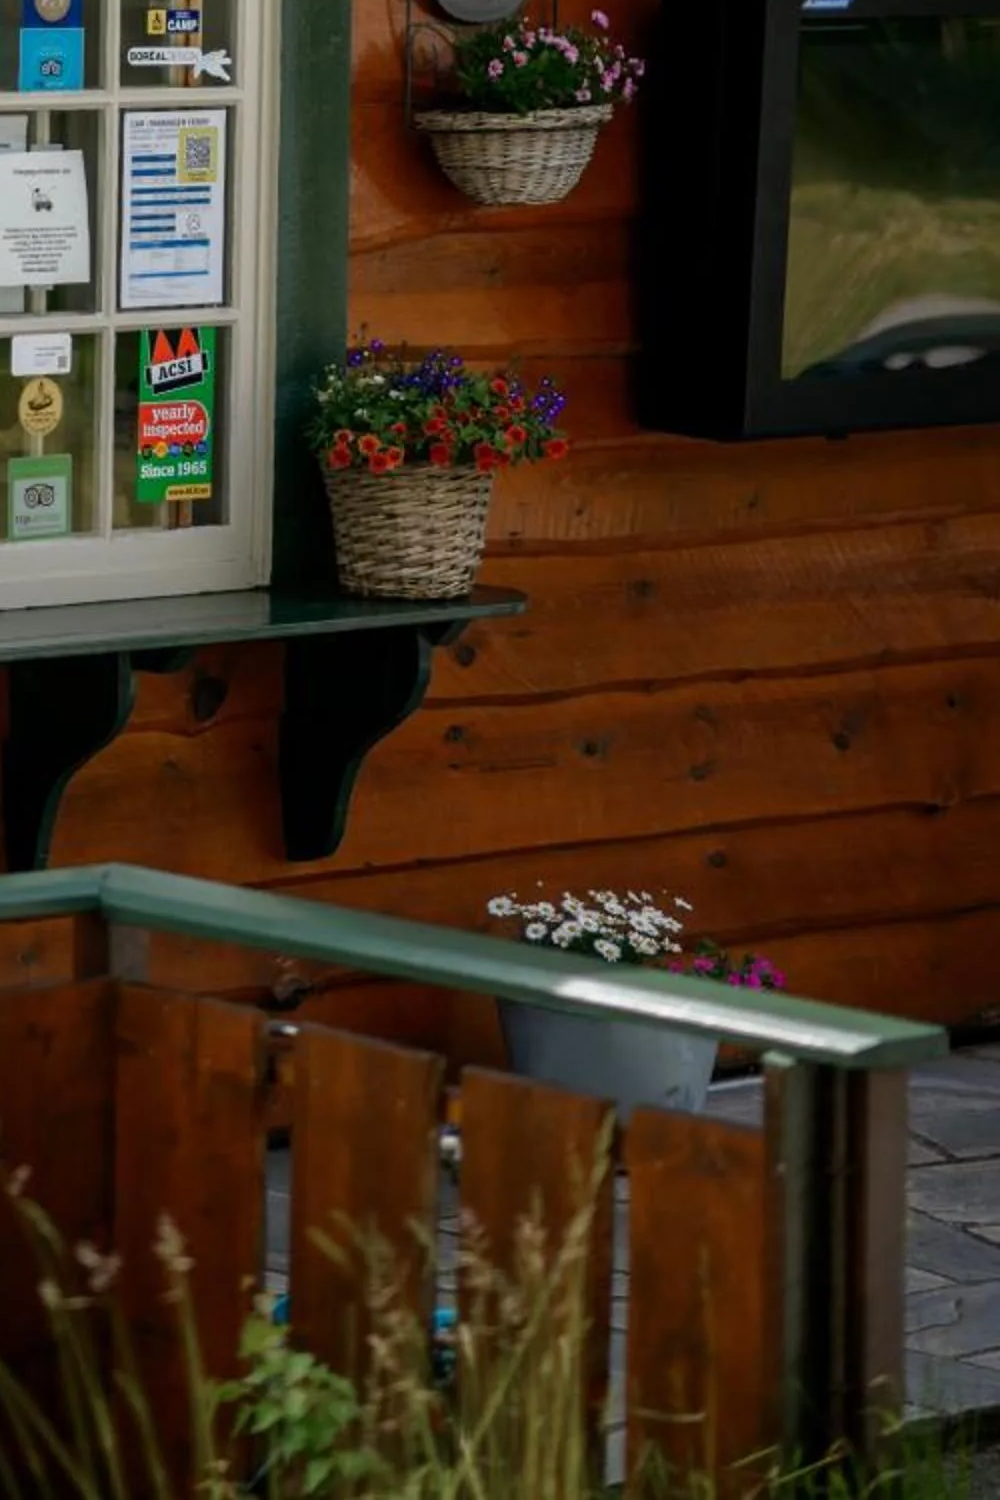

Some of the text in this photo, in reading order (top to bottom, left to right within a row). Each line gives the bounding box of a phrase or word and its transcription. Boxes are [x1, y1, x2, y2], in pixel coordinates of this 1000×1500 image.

[168, 19, 198, 32] CAMP
[158, 359, 194, 382] ACSI
[152, 404, 197, 423] yearly
[143, 420, 205, 440] inspected
[140, 460, 208, 479] Since 1965
